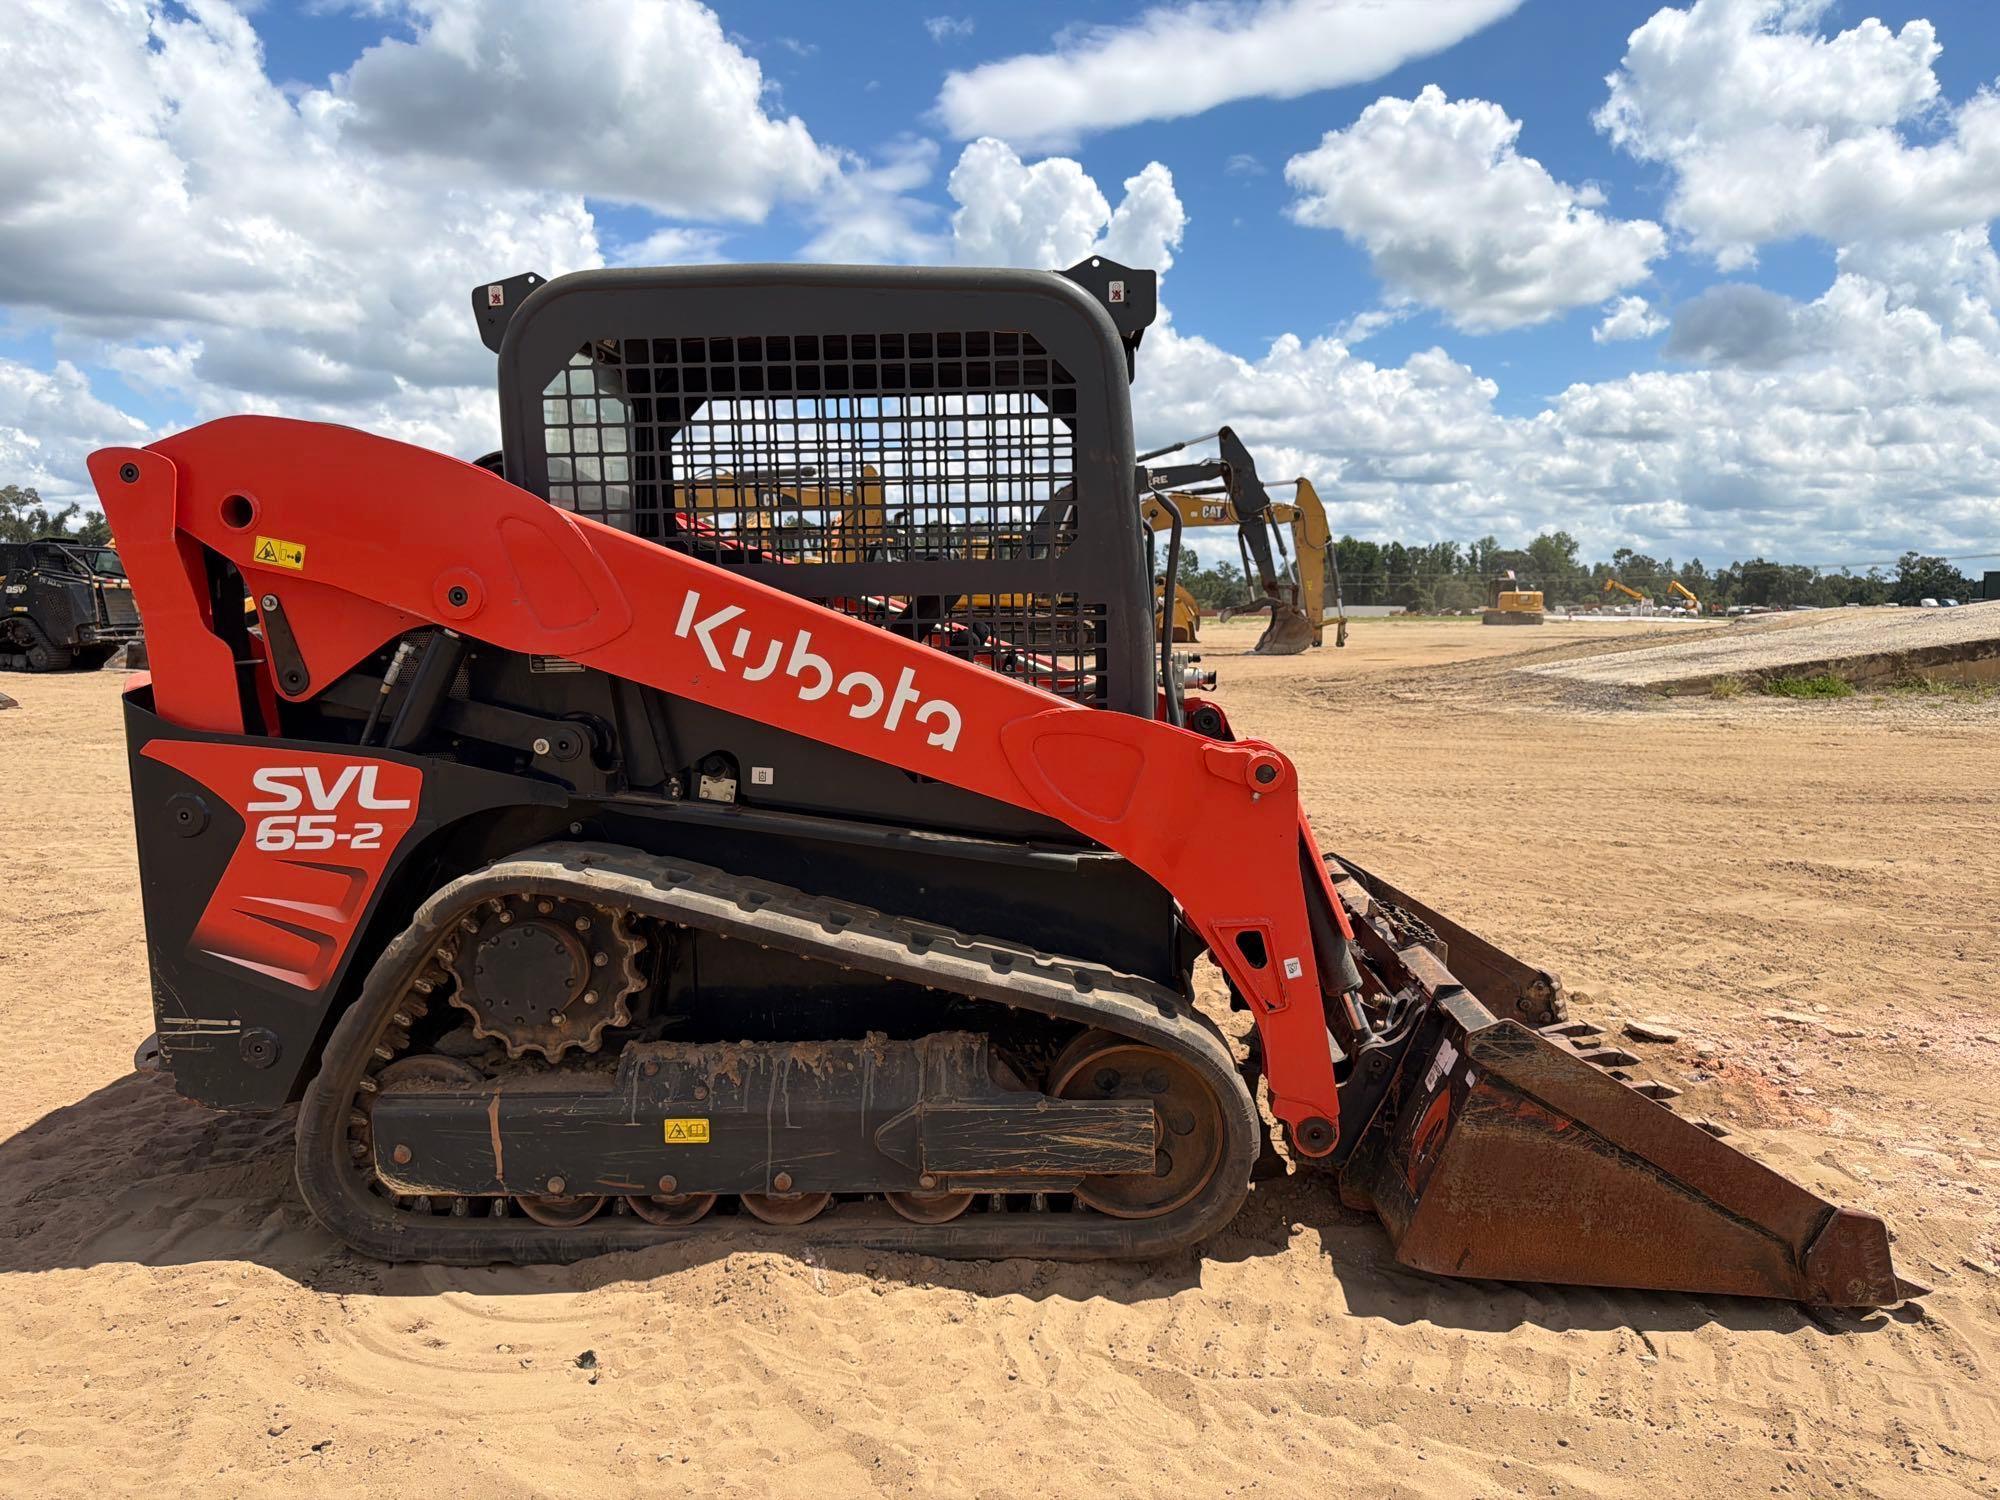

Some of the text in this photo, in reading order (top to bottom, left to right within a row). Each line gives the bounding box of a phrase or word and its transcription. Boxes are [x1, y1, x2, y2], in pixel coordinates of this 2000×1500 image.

[1202, 506, 1223, 518] CAT
[675, 589, 962, 752] Kubota
[247, 766, 411, 811] SVL
[256, 815, 383, 851] 65-2
